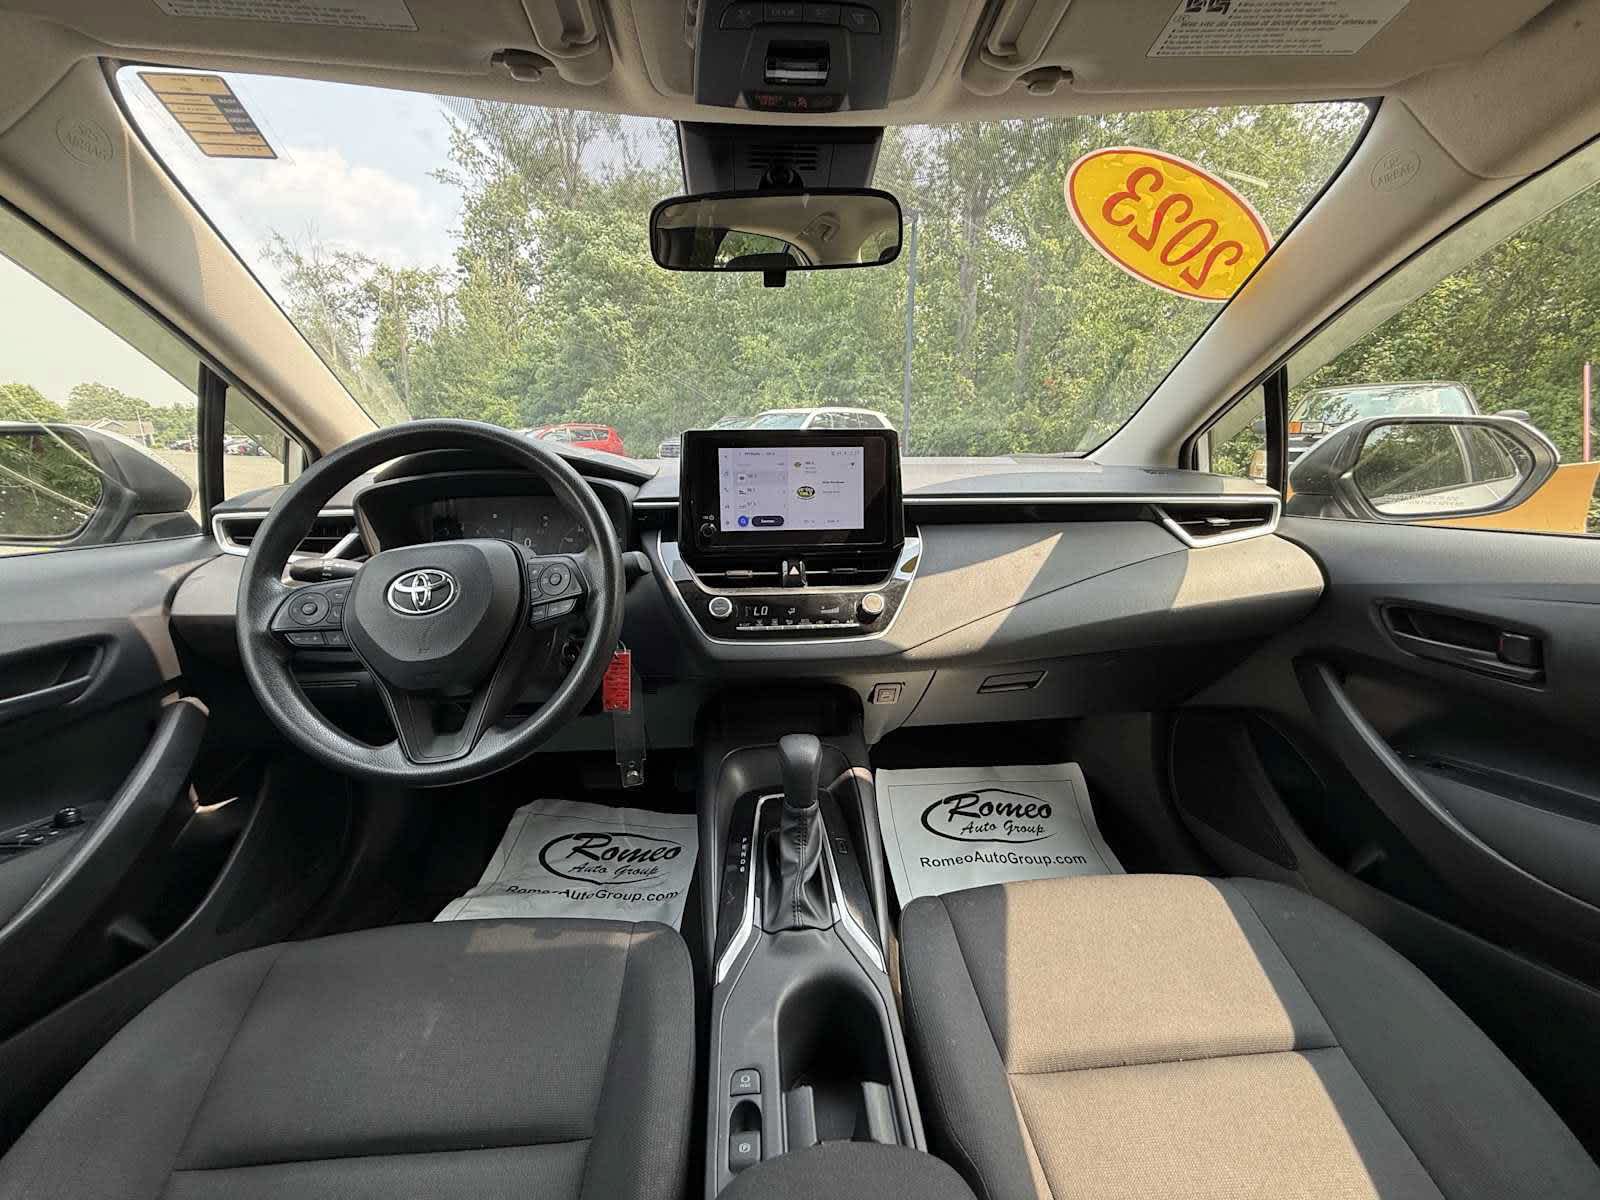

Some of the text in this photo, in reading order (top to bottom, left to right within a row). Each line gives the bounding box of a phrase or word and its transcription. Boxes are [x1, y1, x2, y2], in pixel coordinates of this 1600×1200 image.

[753, 605, 769, 617] LO
[943, 793, 1053, 822] Romeo
[960, 819, 1046, 836] Auto Group
[565, 832, 682, 863] Romeo
[919, 850, 1088, 868] RomeoAutoGroup.com
[568, 861, 660, 879] Auto Group
